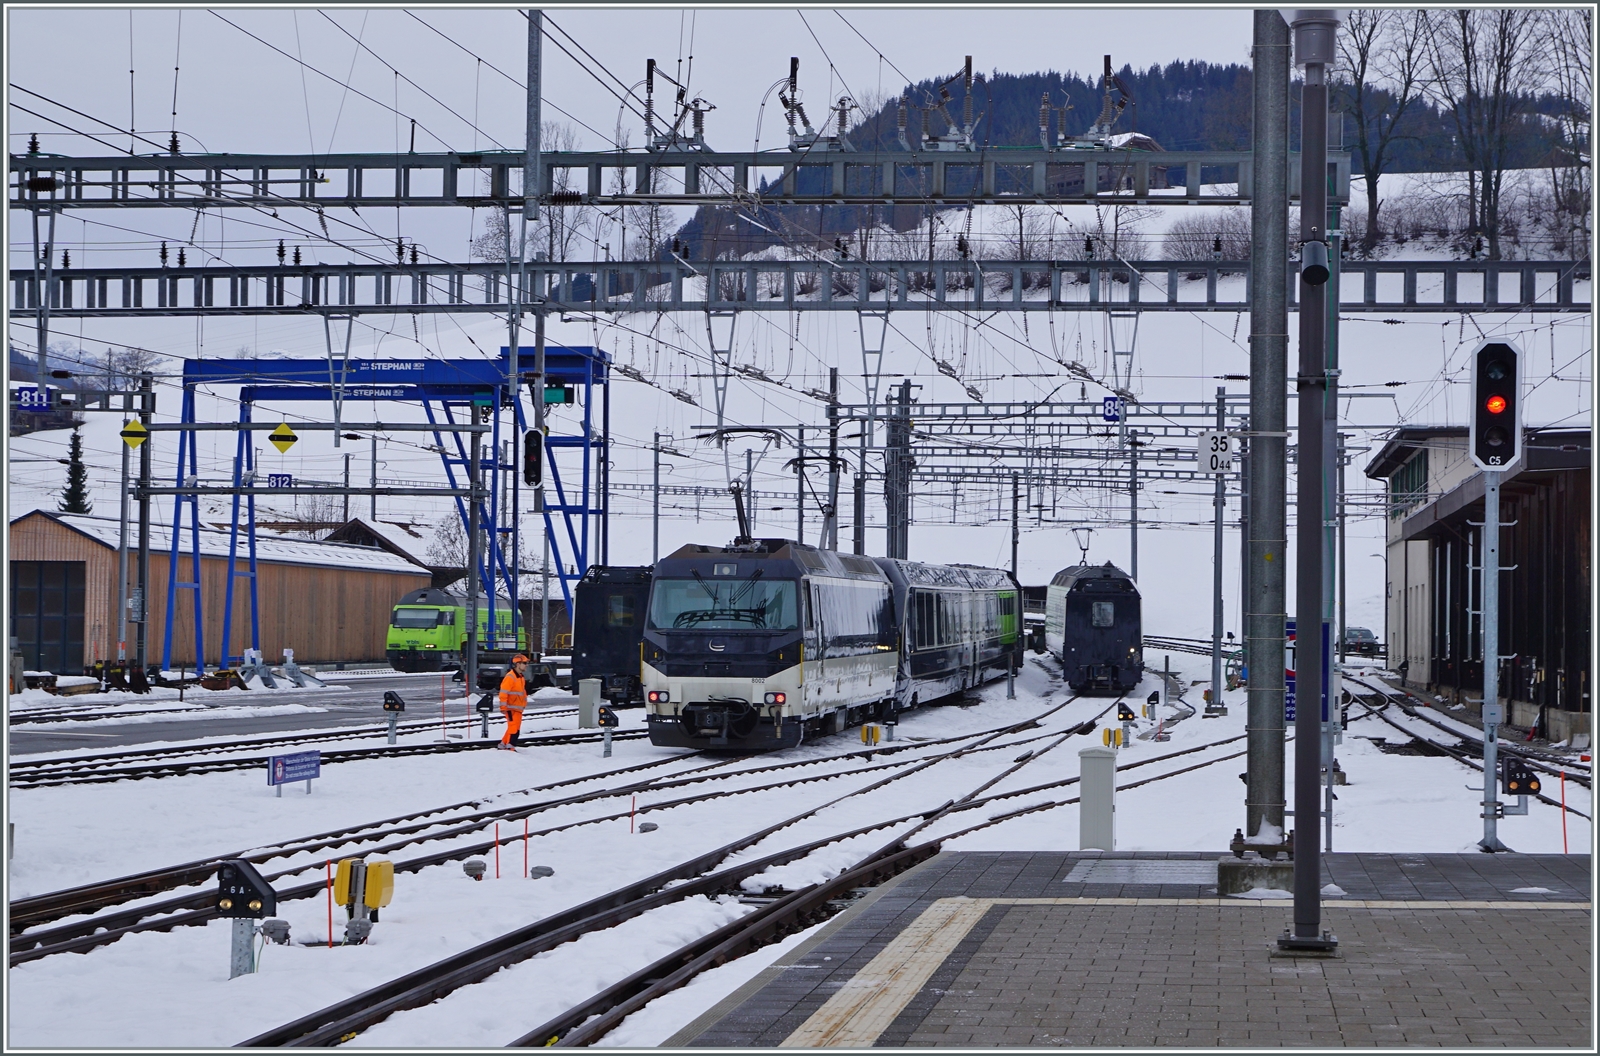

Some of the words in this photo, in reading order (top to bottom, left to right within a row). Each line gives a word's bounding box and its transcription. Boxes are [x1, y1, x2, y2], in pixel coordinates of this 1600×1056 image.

[21, 390, 47, 406] 811
[1211, 436, 1228, 452] 35
[1489, 456, 1501, 464] C5
[270, 476, 290, 488] 812
